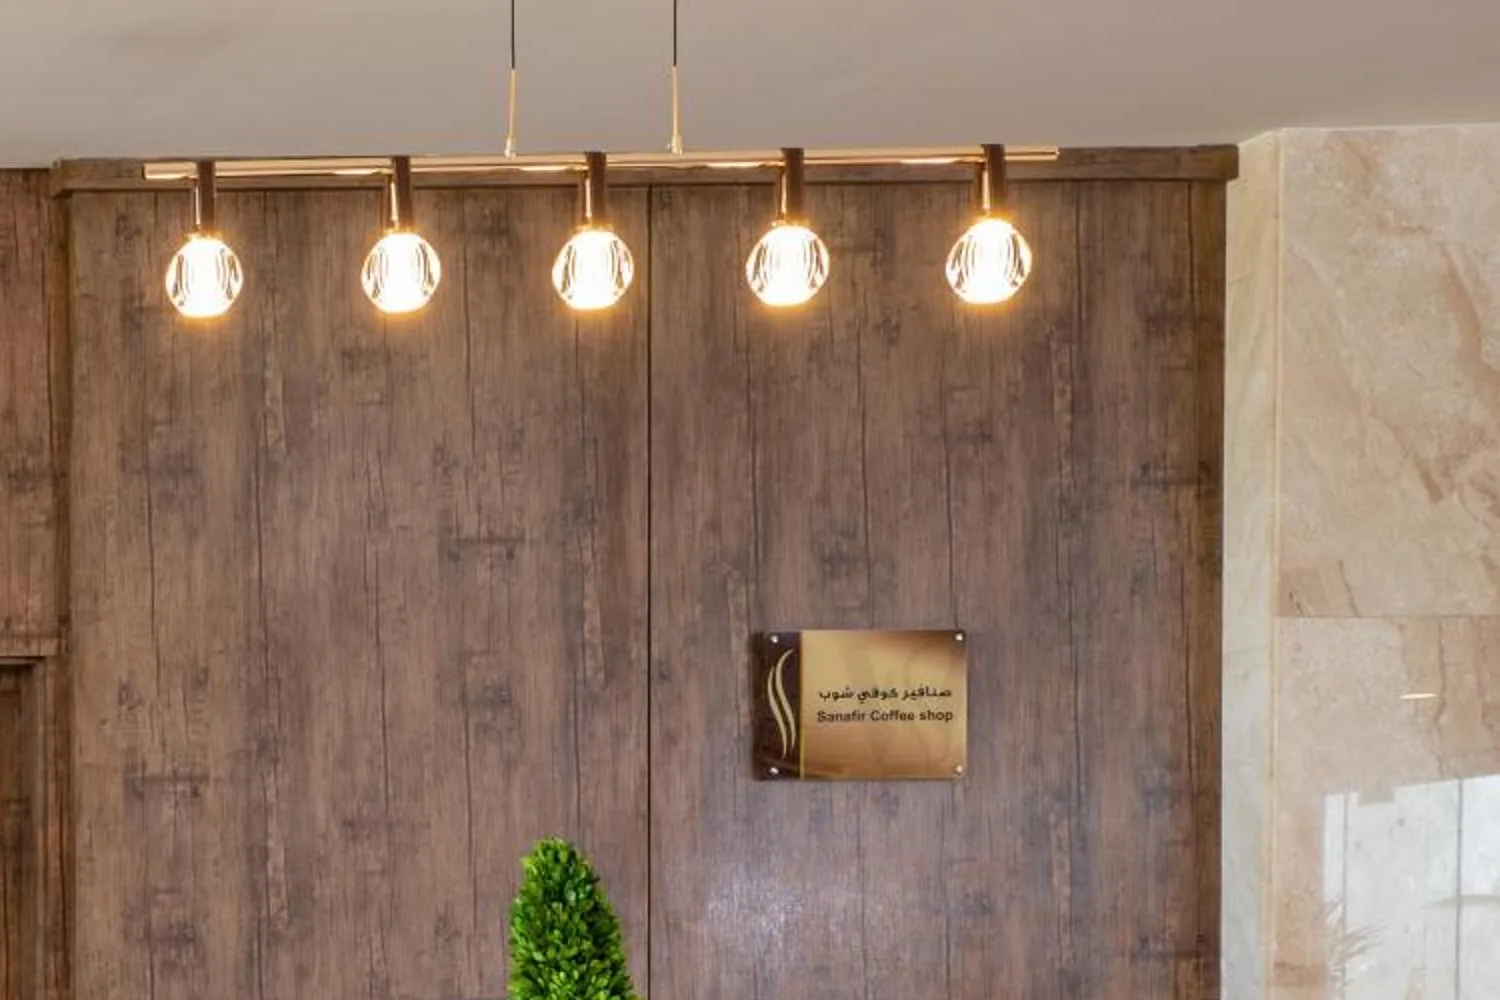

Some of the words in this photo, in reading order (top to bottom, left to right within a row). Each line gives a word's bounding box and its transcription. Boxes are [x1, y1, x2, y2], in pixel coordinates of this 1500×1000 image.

[816, 710, 866, 723] Sanafir
[869, 709, 915, 722] Coffee
[919, 709, 953, 723] shop
